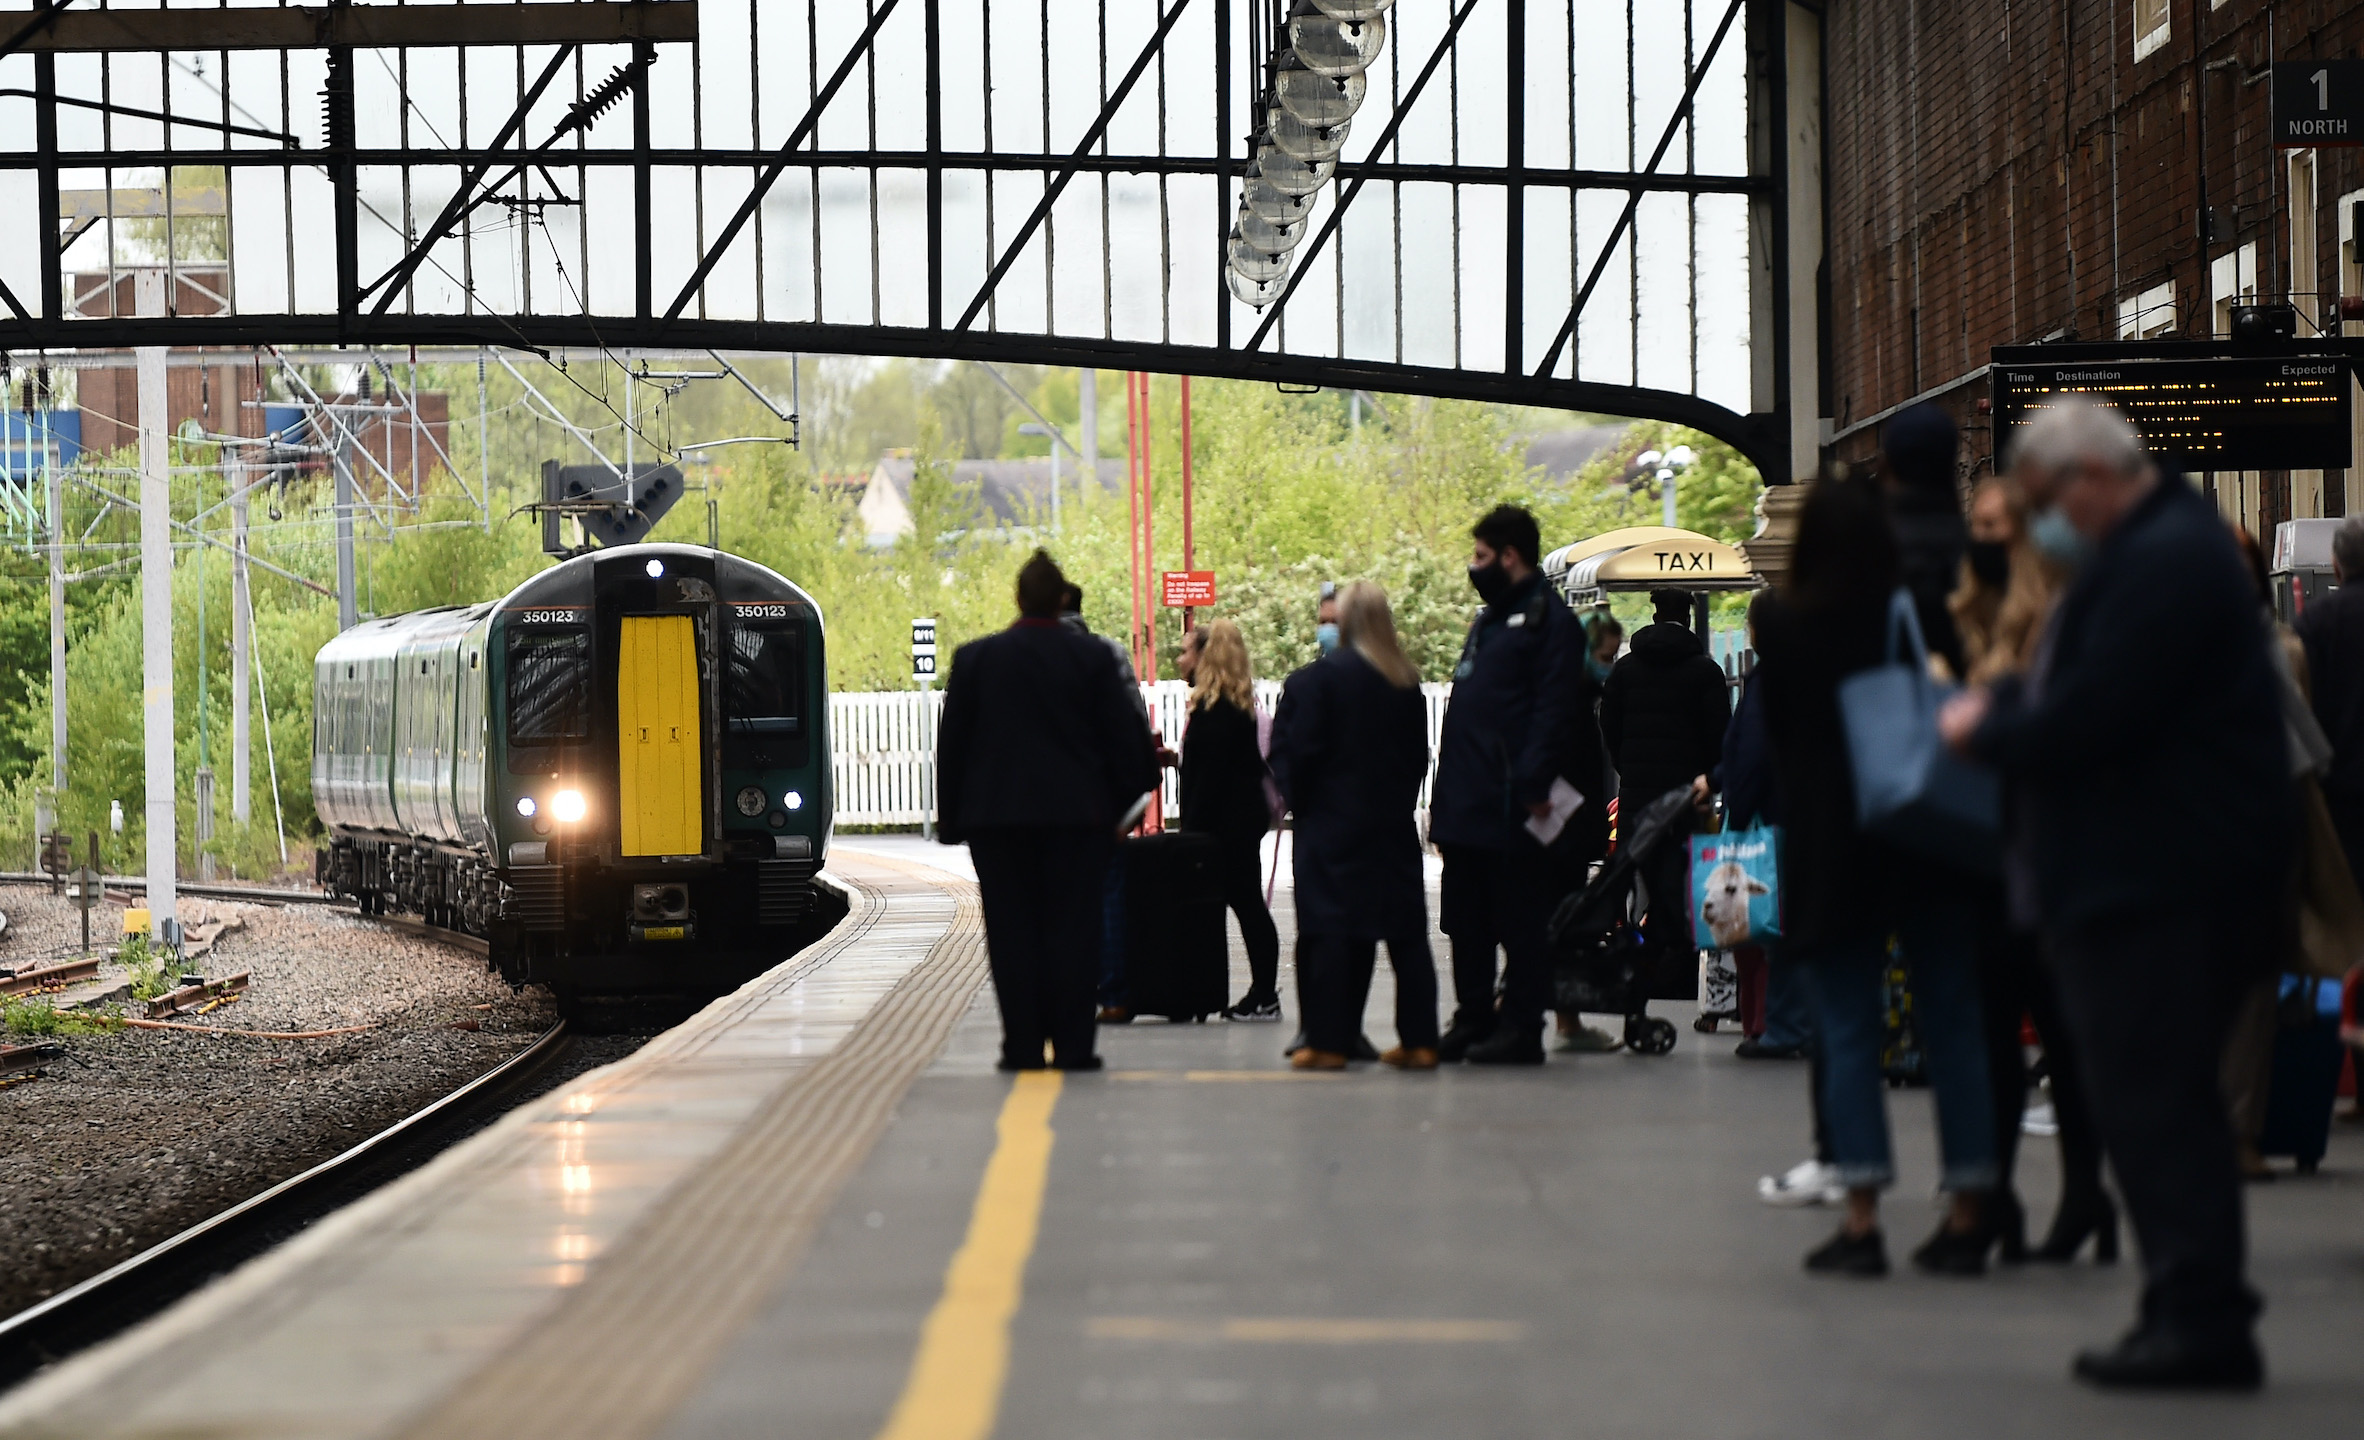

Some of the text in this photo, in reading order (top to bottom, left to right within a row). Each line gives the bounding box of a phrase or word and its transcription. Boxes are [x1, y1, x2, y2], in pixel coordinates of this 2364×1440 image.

[2310, 69, 2328, 110] 1
[2289, 119, 2347, 135] NORTH
[2007, 370, 2121, 382] Time Destination
[2281, 364, 2336, 376] Expected
[1654, 552, 1713, 571] TAXI
[523, 611, 574, 623] 350123
[735, 605, 787, 617] 350123
[916, 657, 934, 671] 10
